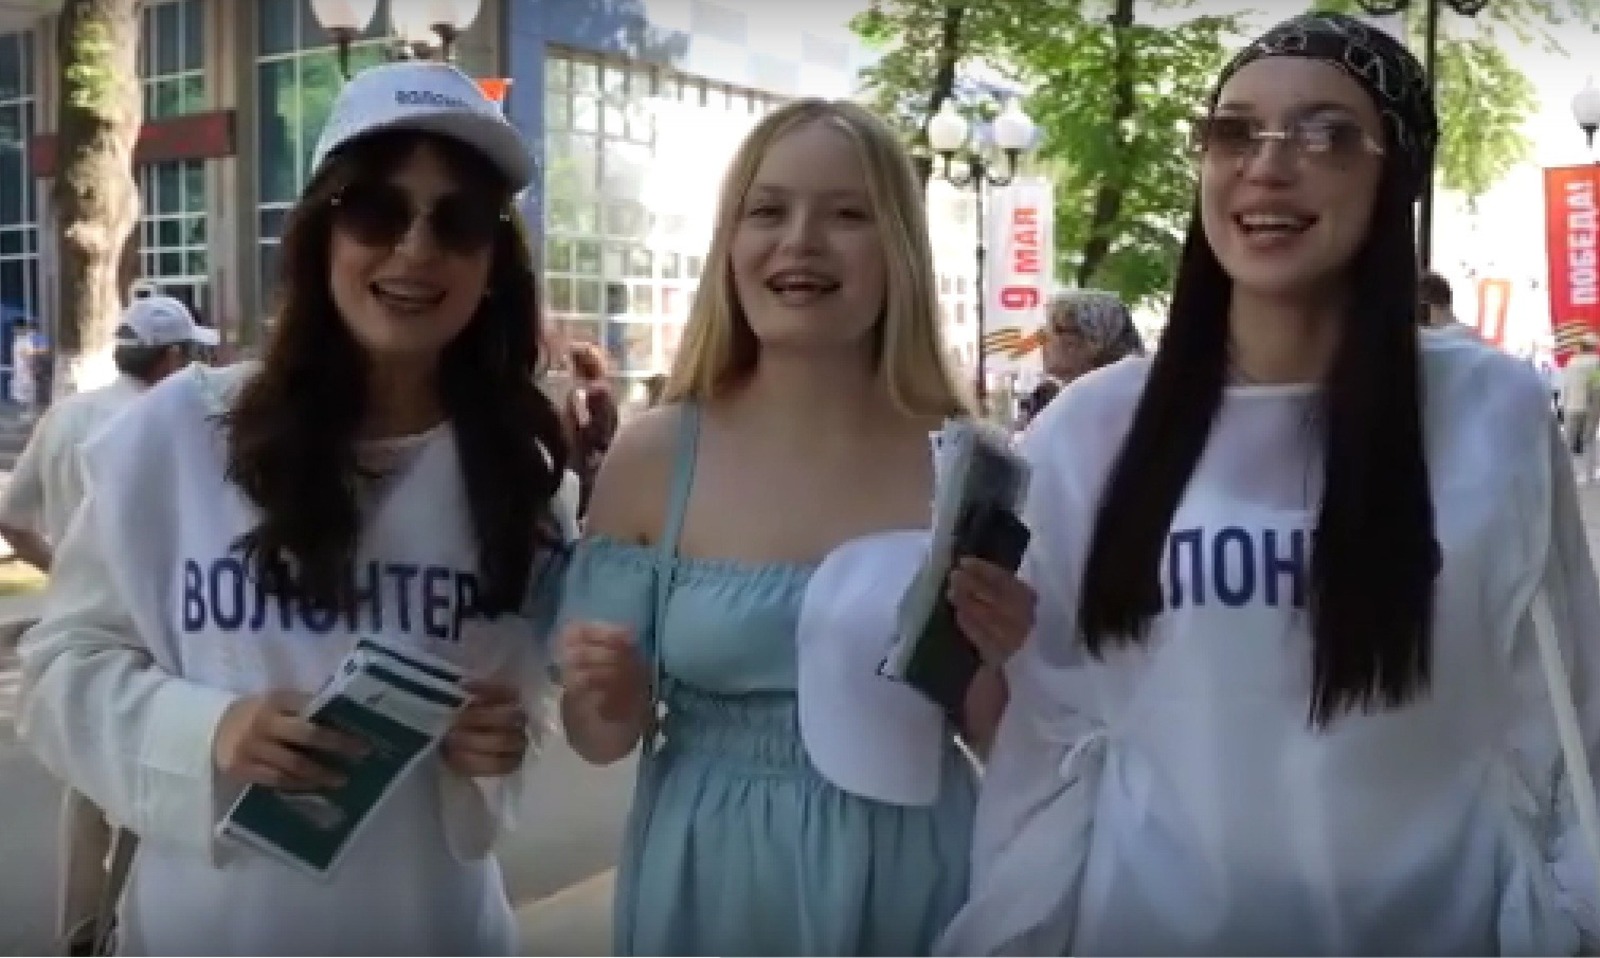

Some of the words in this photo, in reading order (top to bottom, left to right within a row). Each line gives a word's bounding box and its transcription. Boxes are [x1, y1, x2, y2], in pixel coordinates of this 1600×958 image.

[1013, 207, 1039, 273] МАЯ
[1565, 181, 1597, 305] ПОБЕДА!
[1001, 287, 1038, 309] 9
